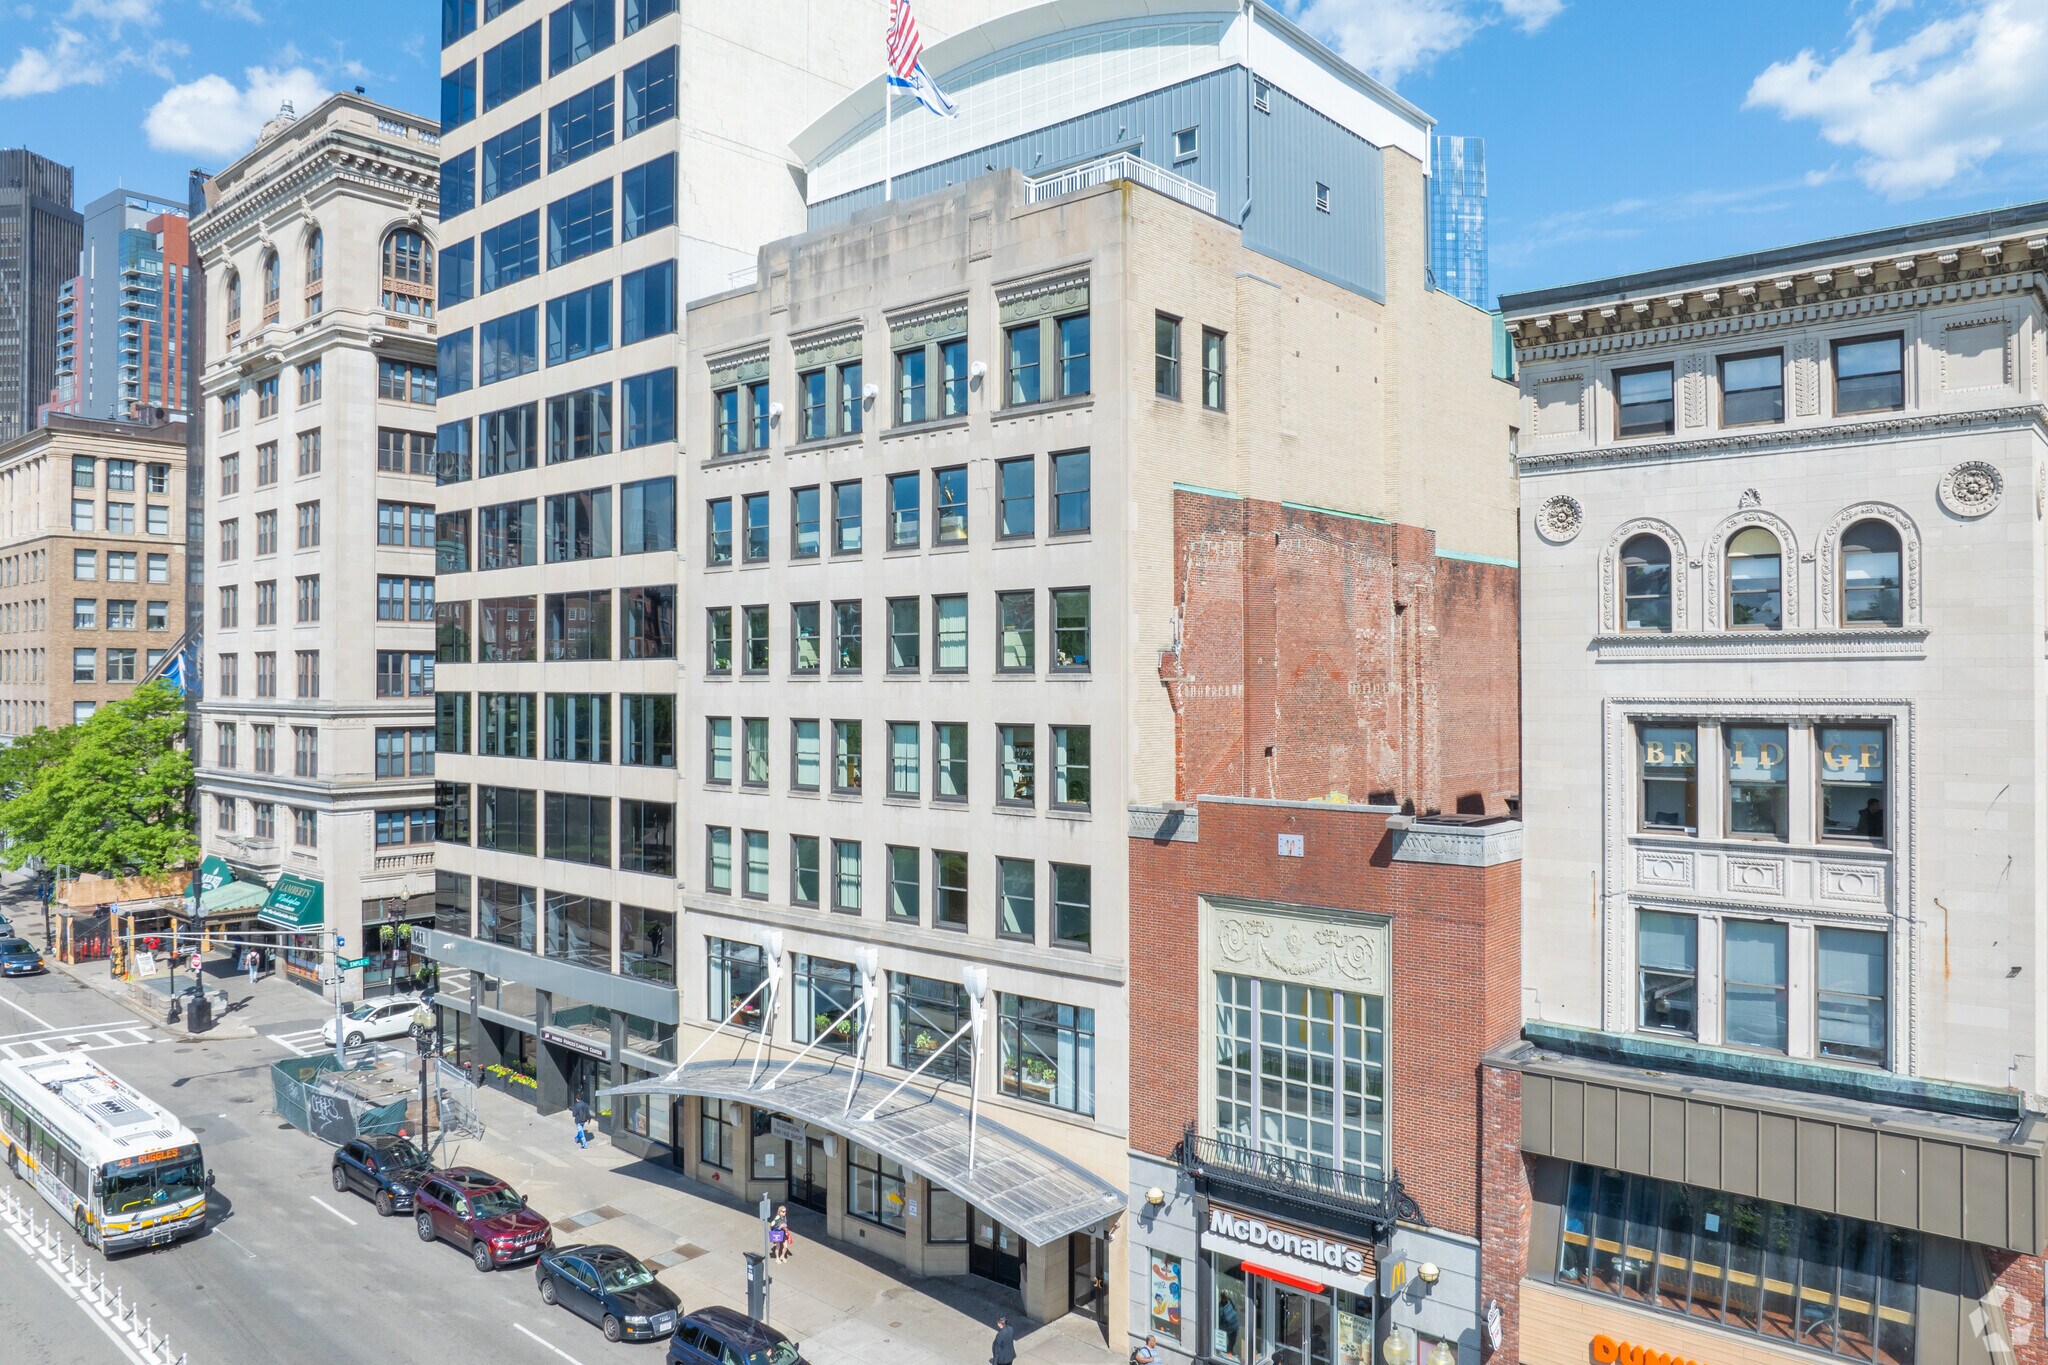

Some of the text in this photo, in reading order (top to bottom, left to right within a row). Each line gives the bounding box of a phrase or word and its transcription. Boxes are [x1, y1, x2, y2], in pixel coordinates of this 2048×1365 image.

[1645, 741, 1881, 769] BRIDGE
[119, 1148, 179, 1168] 43 RUGGLES
[1210, 1208, 1364, 1273] McDonald's
